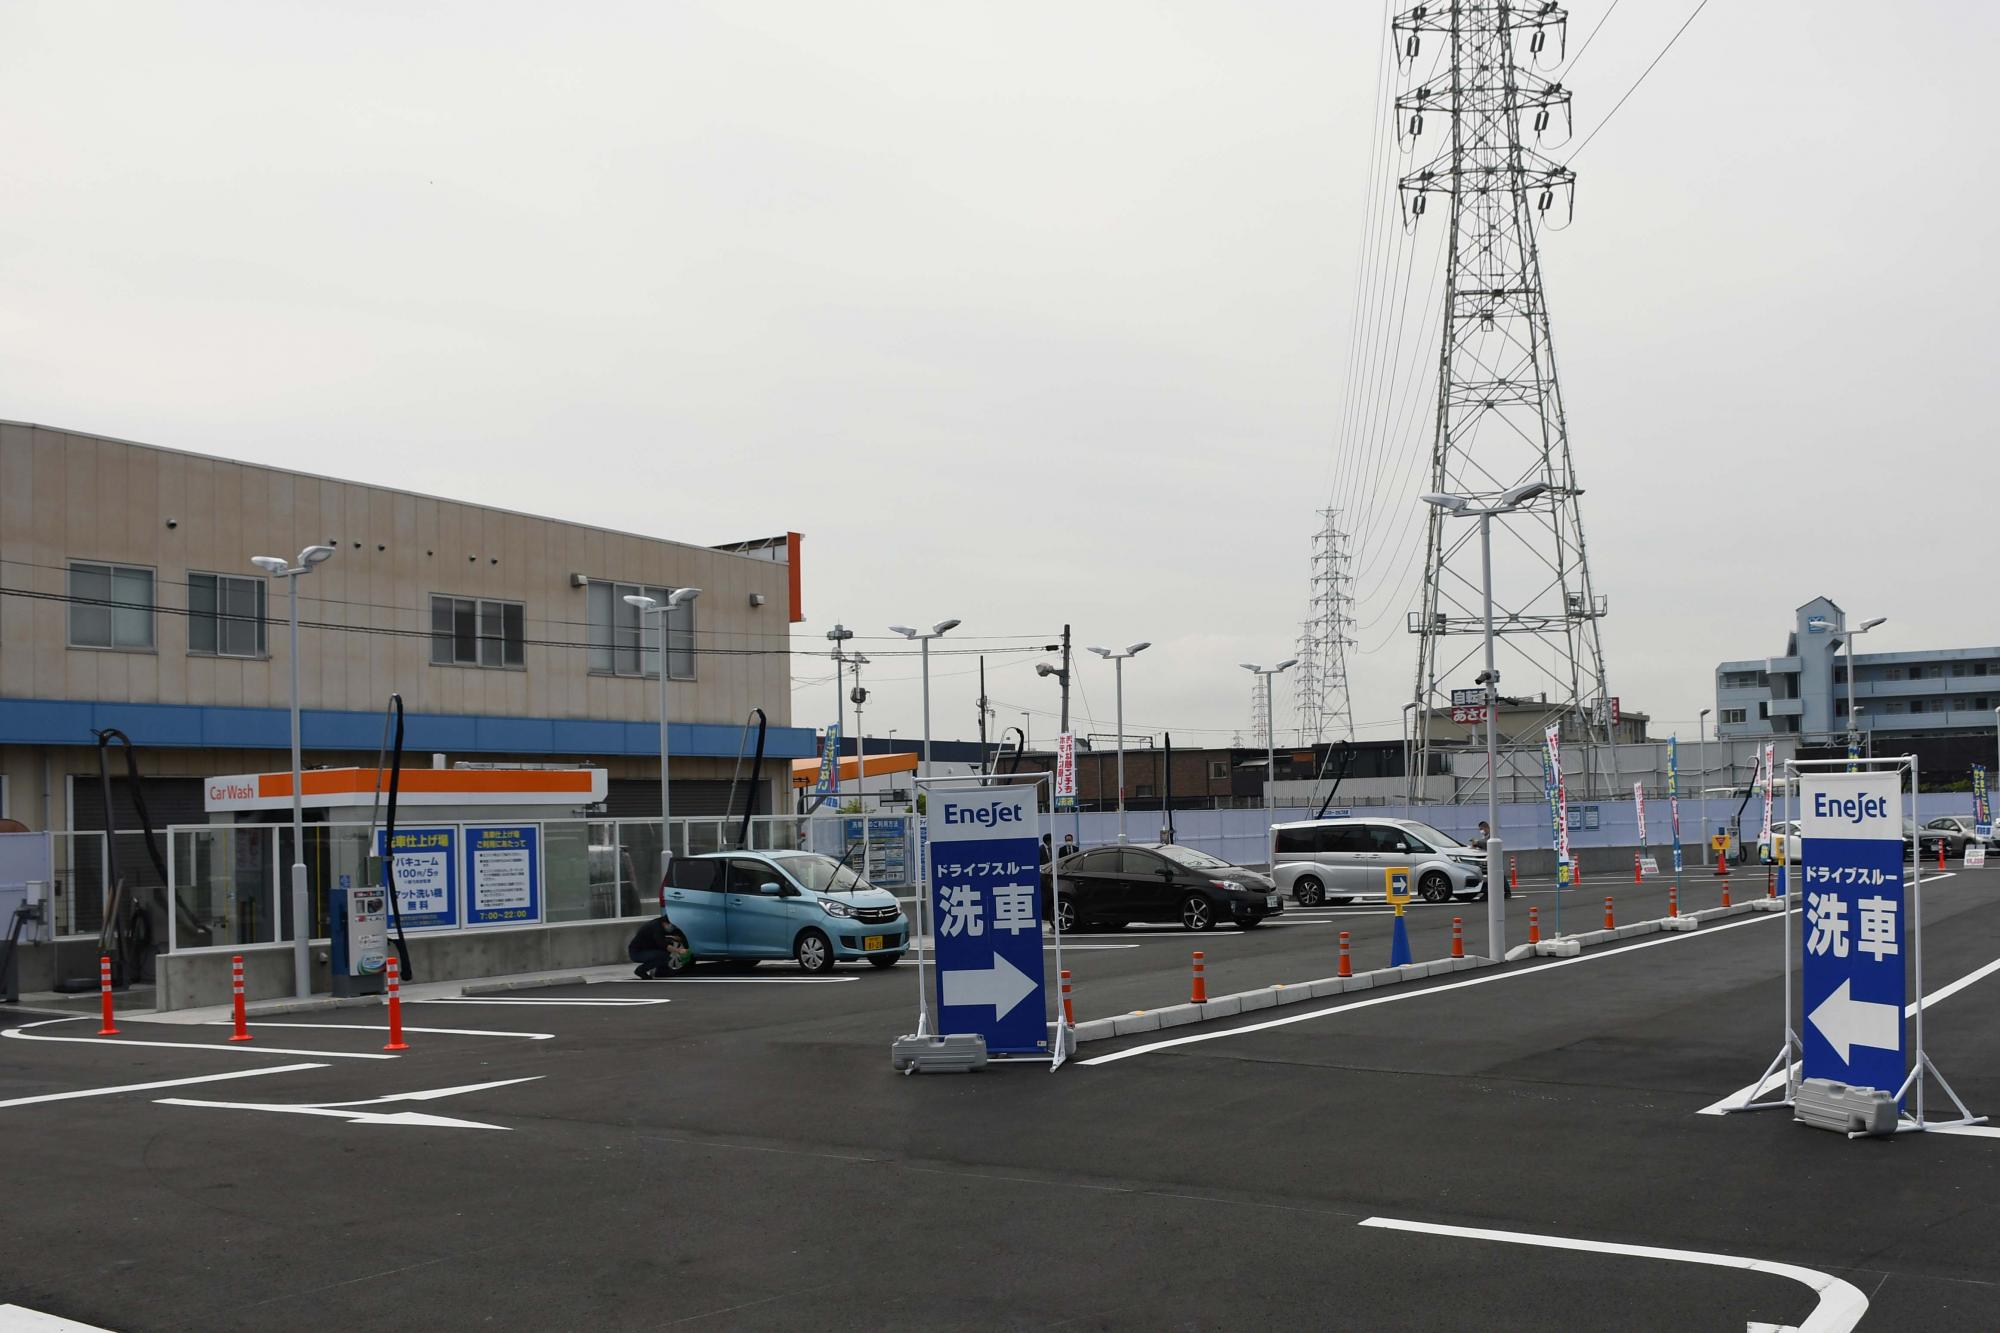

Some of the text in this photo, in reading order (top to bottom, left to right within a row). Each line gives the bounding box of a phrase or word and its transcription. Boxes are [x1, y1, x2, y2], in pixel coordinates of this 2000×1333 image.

[210, 784, 254, 801] Car Wash
[395, 857, 439, 867] バキューム
[937, 861, 1035, 878] ドライブスルー
[1806, 866, 1898, 886] ドライブスルー
[939, 882, 1037, 938] 洗車
[1806, 891, 1899, 962] 洗車
